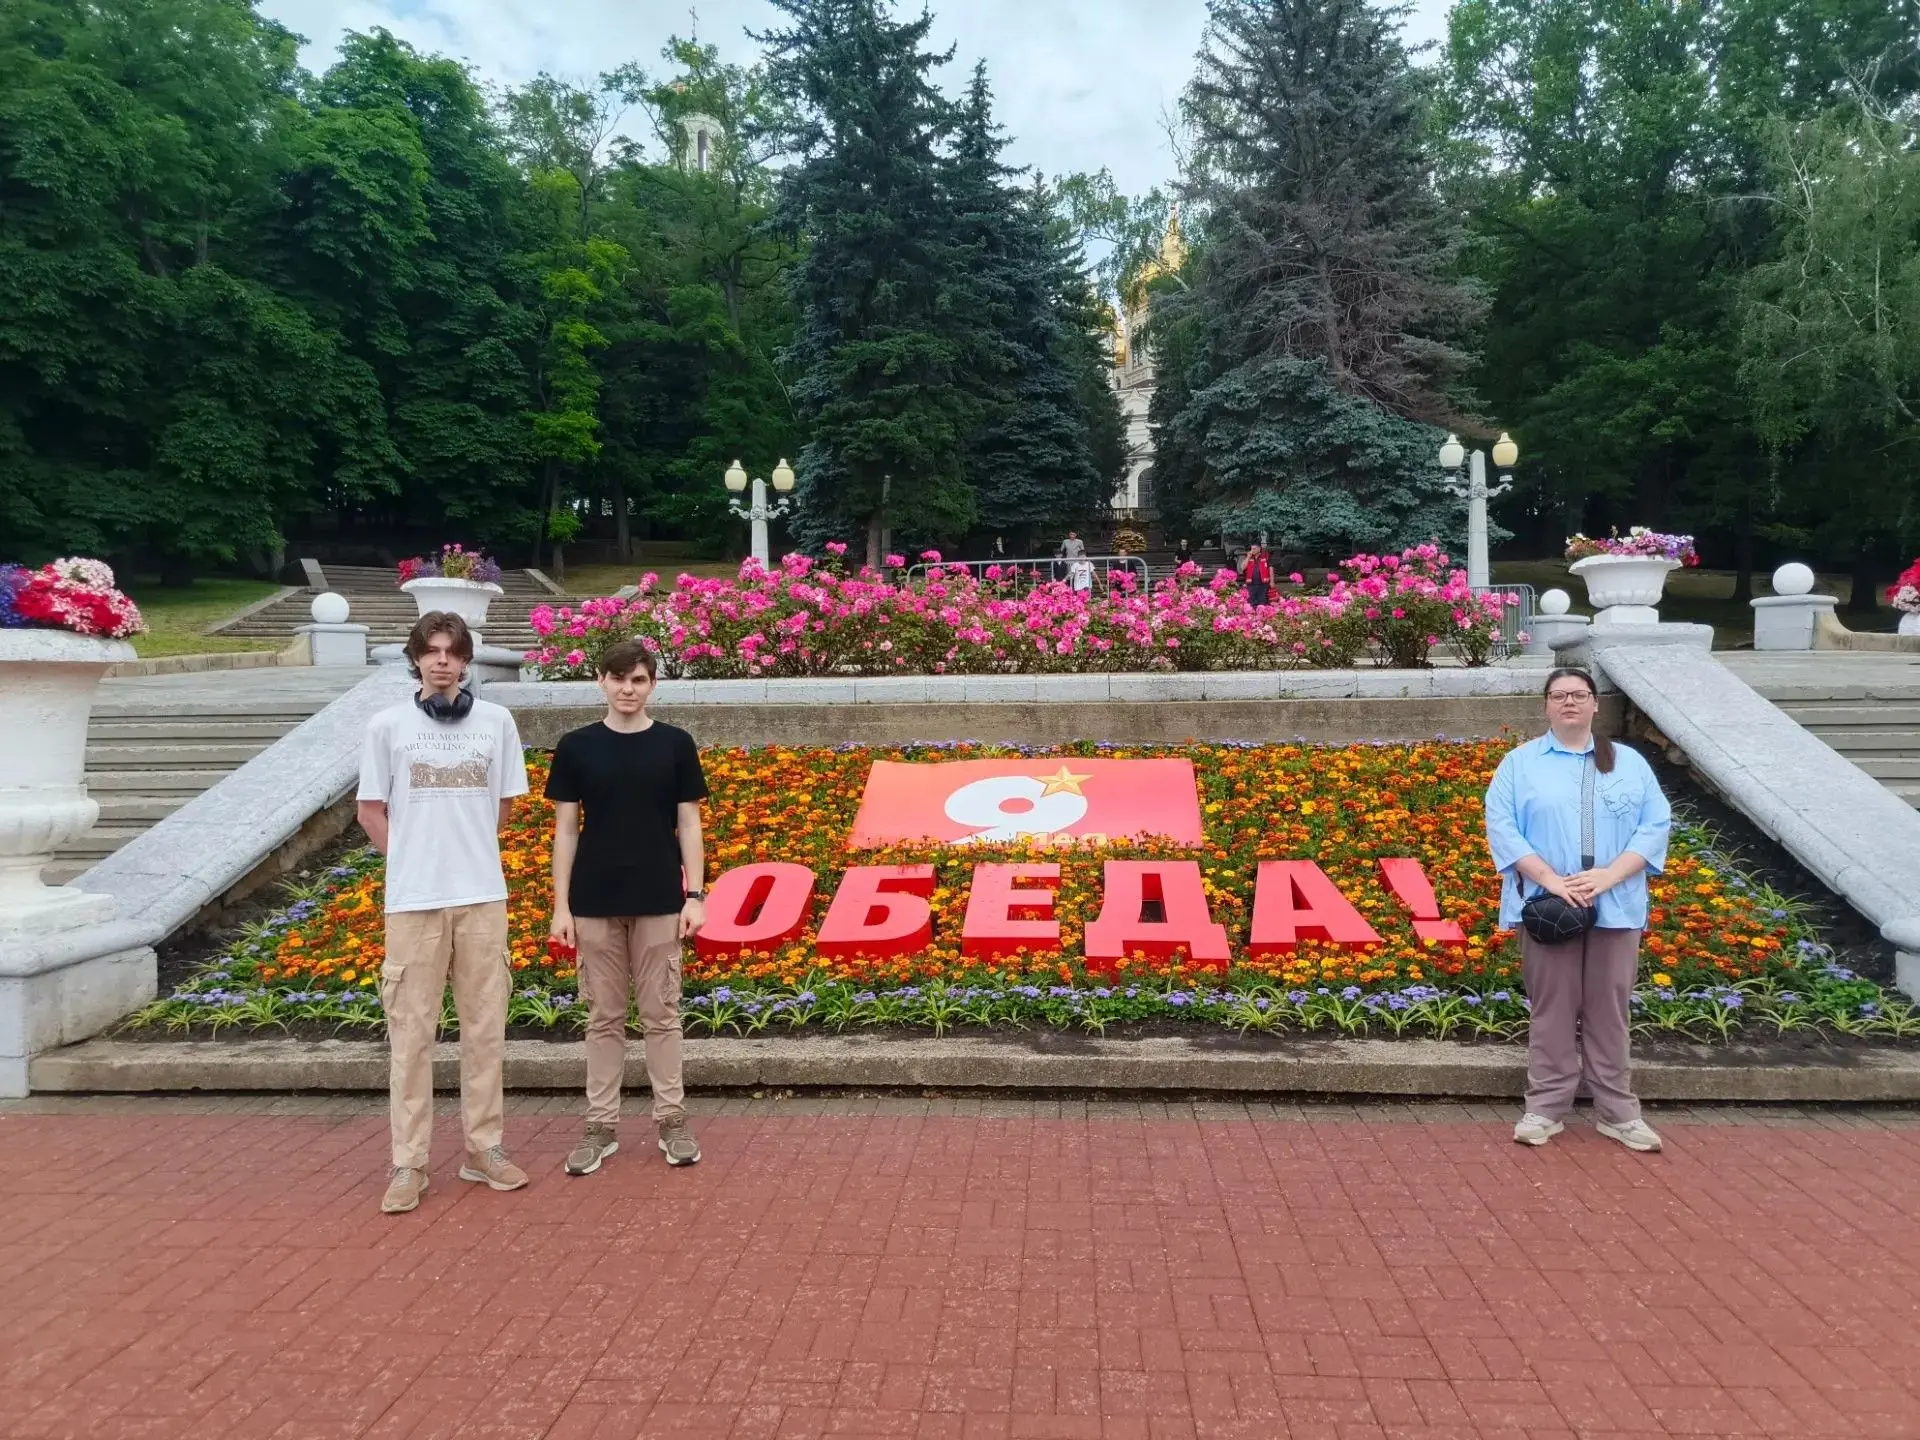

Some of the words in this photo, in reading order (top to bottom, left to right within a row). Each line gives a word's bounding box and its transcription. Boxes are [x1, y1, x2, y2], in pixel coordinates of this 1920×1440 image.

[404, 742, 421, 752] ARE
[424, 742, 466, 751] CALLING
[416, 732, 435, 741] THE
[944, 775, 1088, 846] 9
[547, 857, 1466, 966] ОБЕДА!
